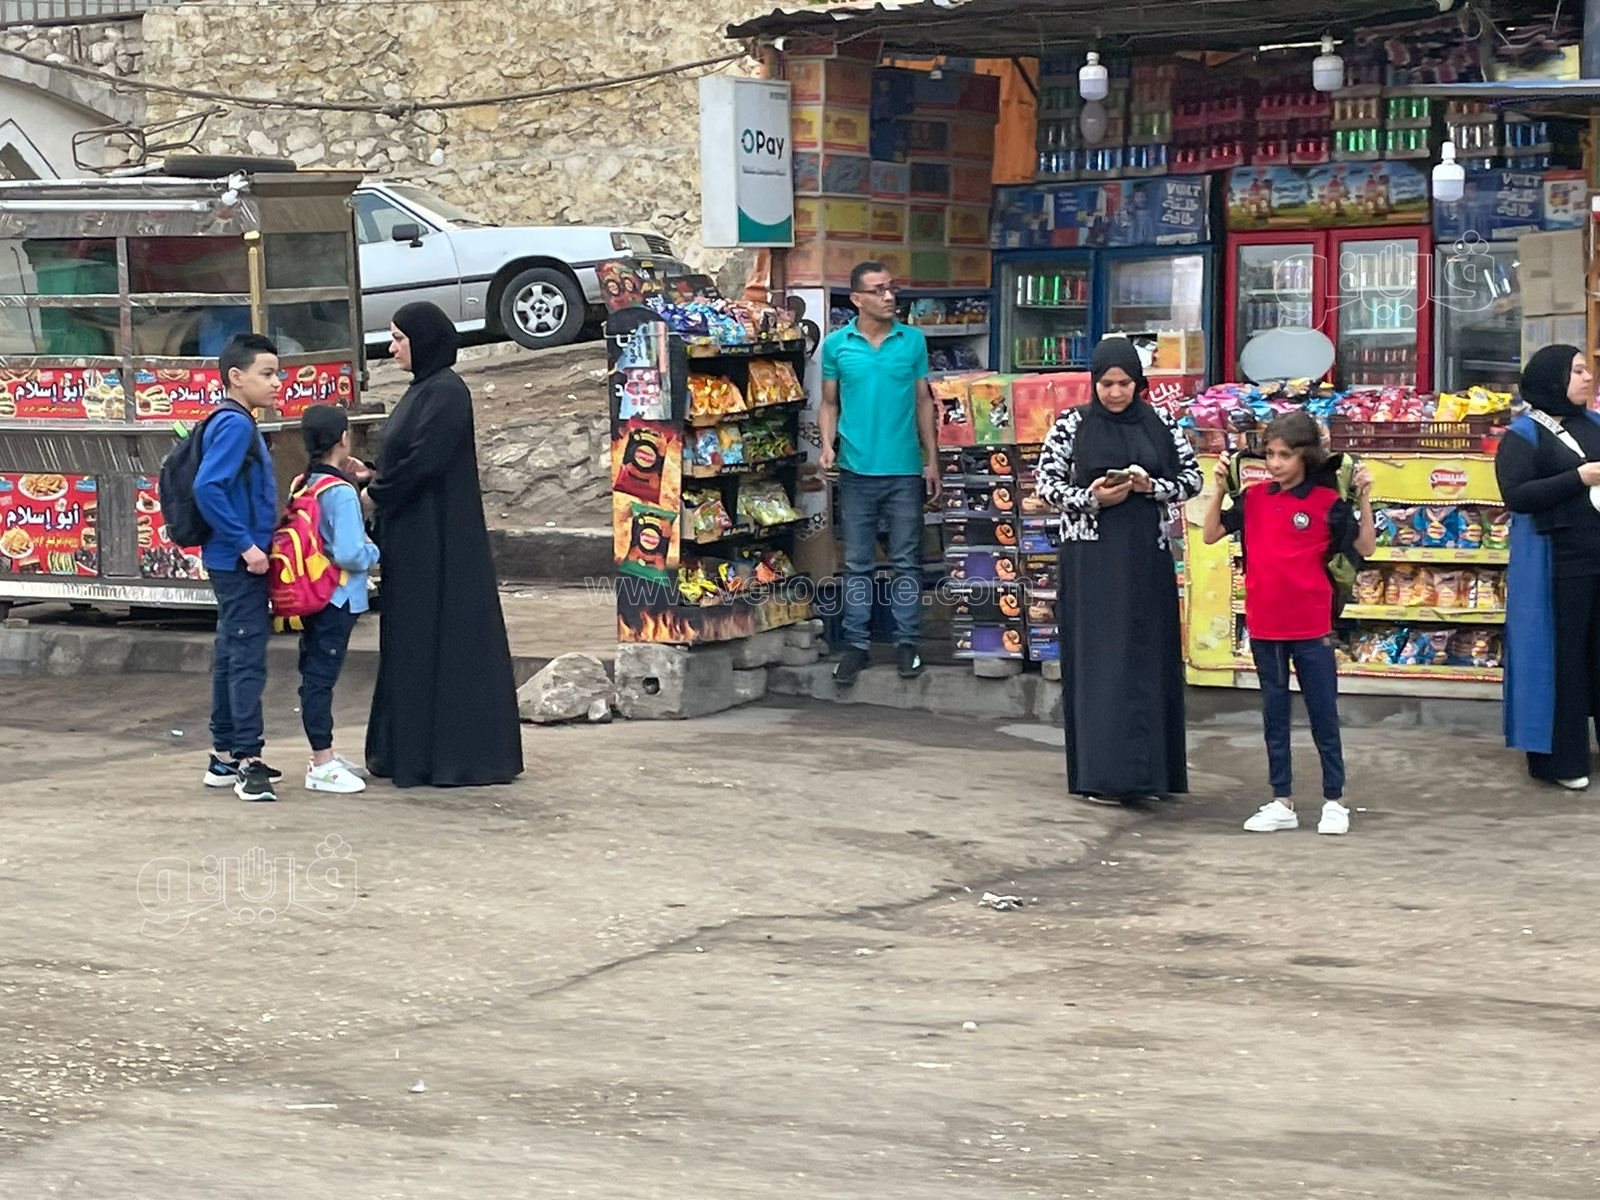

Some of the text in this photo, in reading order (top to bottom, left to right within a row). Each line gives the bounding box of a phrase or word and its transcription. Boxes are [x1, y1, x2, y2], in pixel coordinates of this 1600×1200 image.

[741, 128, 785, 160] OPay
[1166, 183, 1202, 197] VOLT
[15, 381, 58, 403] إسلام
[62, 378, 83, 402] أبو
[169, 386, 206, 405] إسلام
[285, 382, 318, 401] إسلام
[7, 503, 79, 530] أبو إسلام
